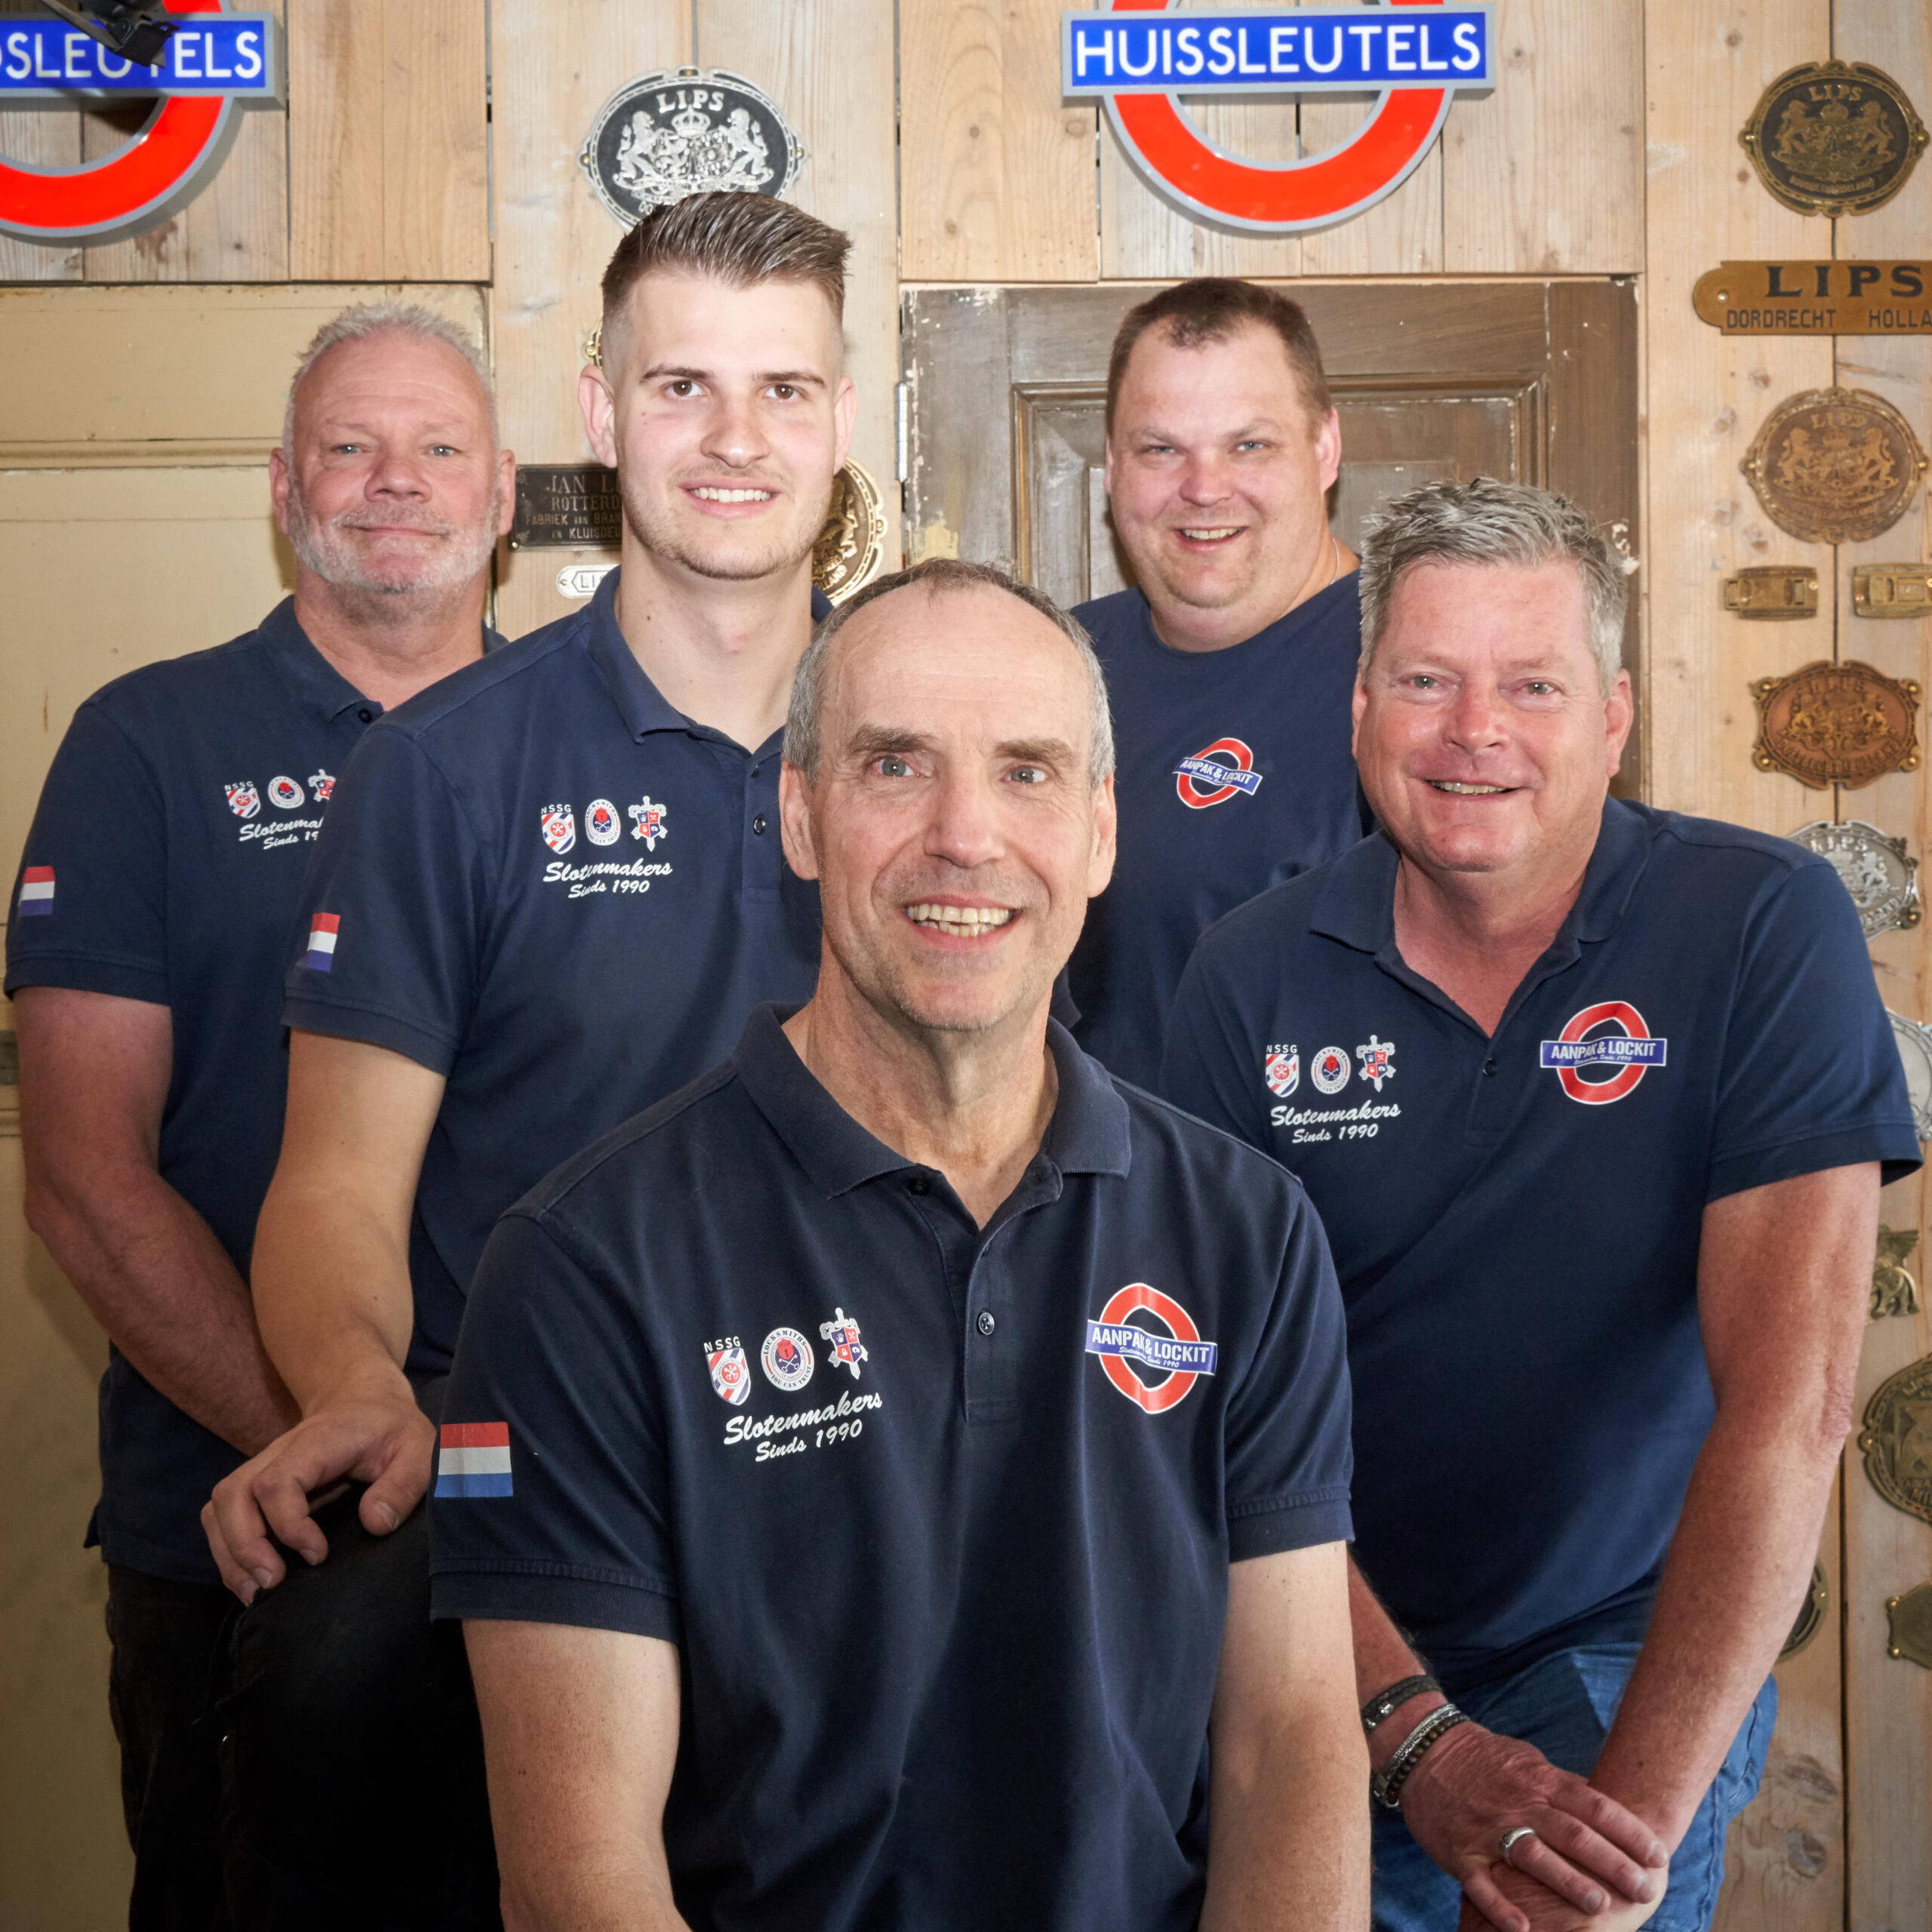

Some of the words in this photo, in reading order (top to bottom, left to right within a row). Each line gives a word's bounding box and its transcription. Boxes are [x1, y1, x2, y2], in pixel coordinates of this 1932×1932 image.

[0, 31, 262, 79] SLEUELS
[1076, 23, 1480, 76] HUISSLEUTELS
[656, 89, 724, 113] LIPS
[1808, 84, 1863, 101] LIPS
[1765, 266, 1924, 297] LIPS
[1727, 309, 1836, 328] DORDRECHT
[546, 475, 585, 494] JAN
[525, 513, 568, 525] FABRIEK
[574, 515, 588, 525] VAN
[1180, 759, 1215, 776] AANPAK
[1214, 768, 1223, 780] &
[1222, 771, 1254, 785] LOCKIT
[224, 780, 254, 791] NSSG
[541, 804, 571, 814] NSSG
[263, 833, 300, 850] Sinds
[612, 879, 650, 894] 1990
[1266, 1044, 1298, 1054] NSSG
[1552, 1042, 1598, 1060] AANPAK
[1597, 1041, 1607, 1054] &
[1607, 1040, 1657, 1057] LOCKIT
[1270, 1100, 1401, 1127] Slotenmakers
[1292, 1128, 1332, 1143] Sinds
[1338, 1123, 1379, 1140] 1990
[703, 1336, 741, 1353] NSSG
[763, 1330, 807, 1355] LOCKSMITHS
[1092, 1326, 1146, 1352] AANPAK
[1145, 1338, 1152, 1355] &
[1154, 1340, 1210, 1363] LOCKIT
[1163, 1359, 1180, 1368] 1990
[771, 1374, 783, 1385] YOU
[798, 1366, 812, 1385] TRUST
[724, 1390, 882, 1444] Slotenmakers
[755, 1436, 807, 1462] Sinds
[816, 1418, 863, 1447] 1990
